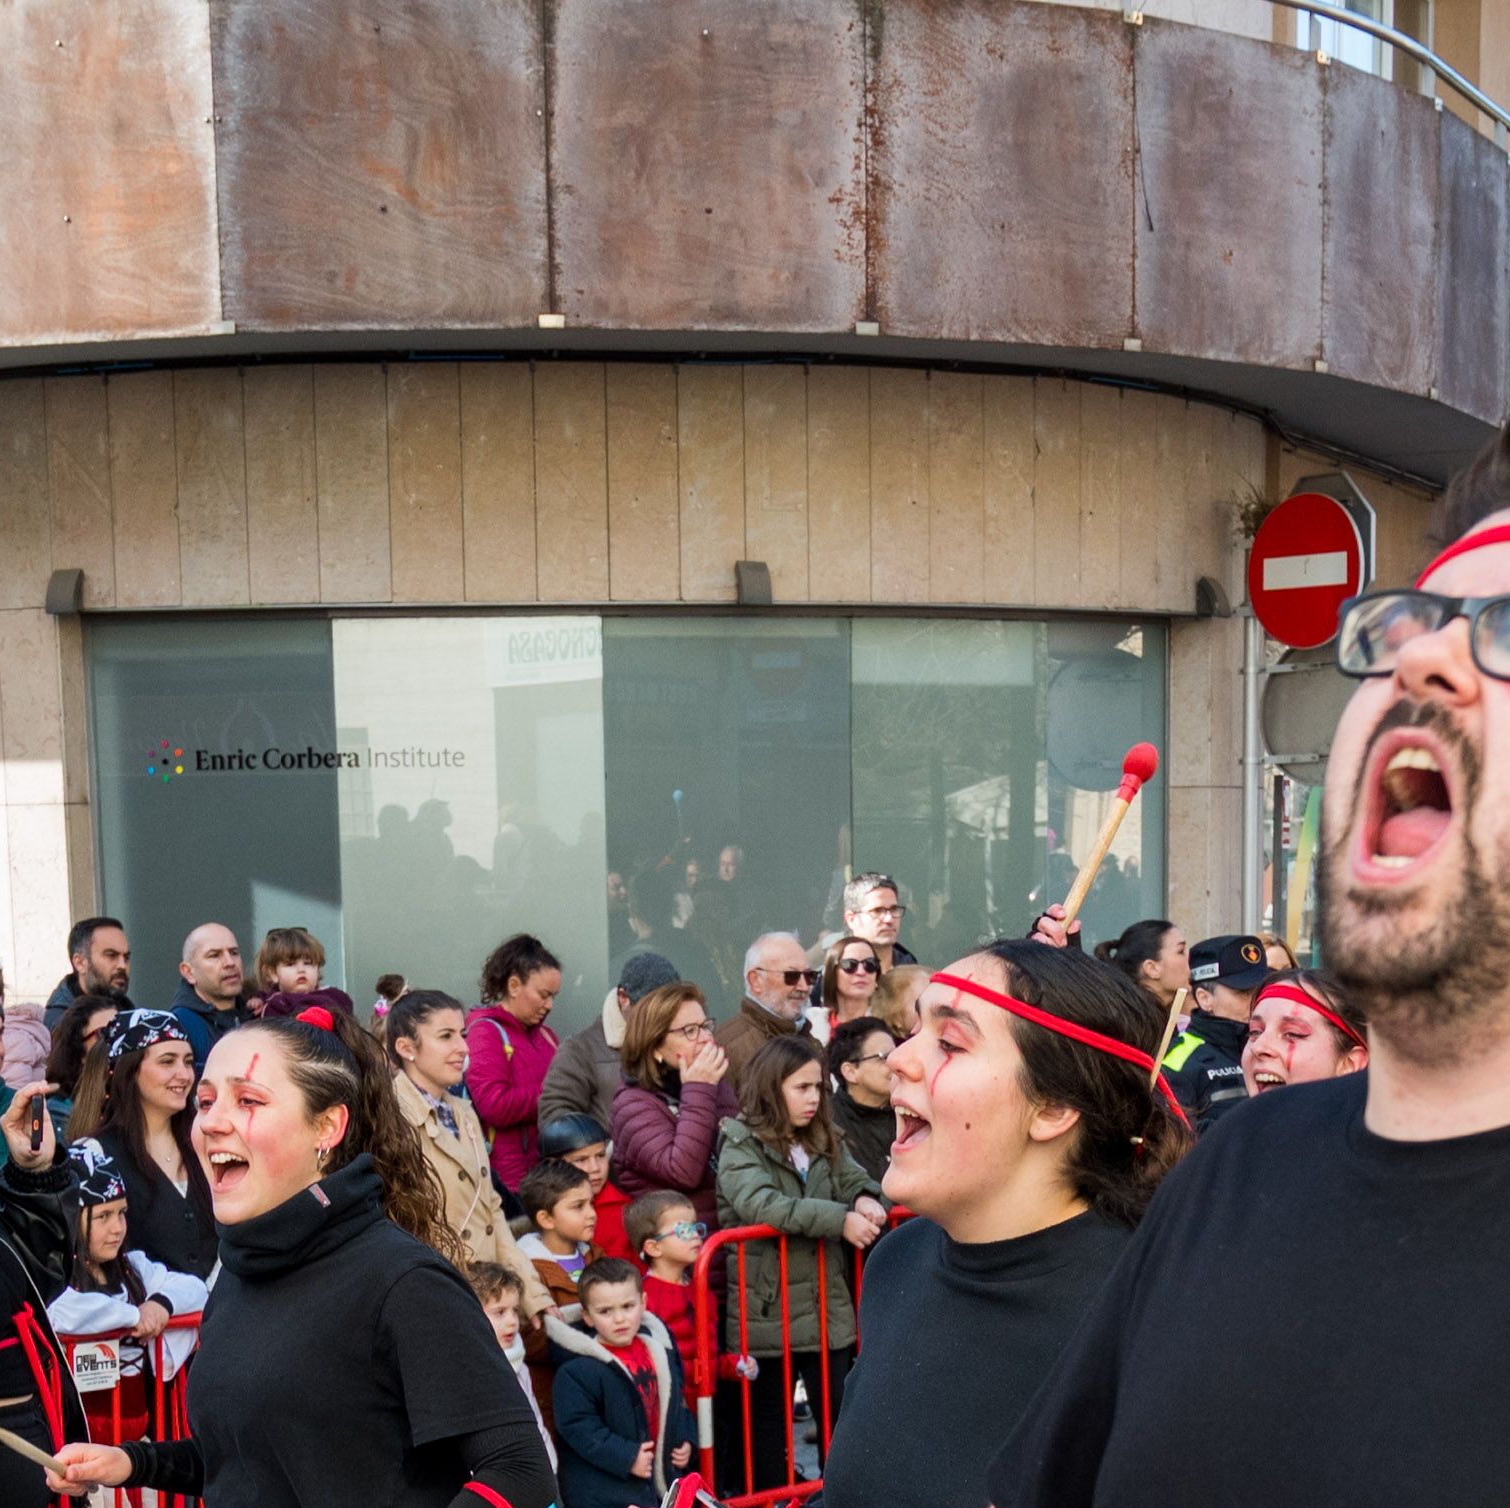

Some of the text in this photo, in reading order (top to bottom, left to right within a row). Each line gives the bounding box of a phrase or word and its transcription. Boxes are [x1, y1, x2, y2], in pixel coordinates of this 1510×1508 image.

[195, 746, 466, 772] Enric Corbera Institute
